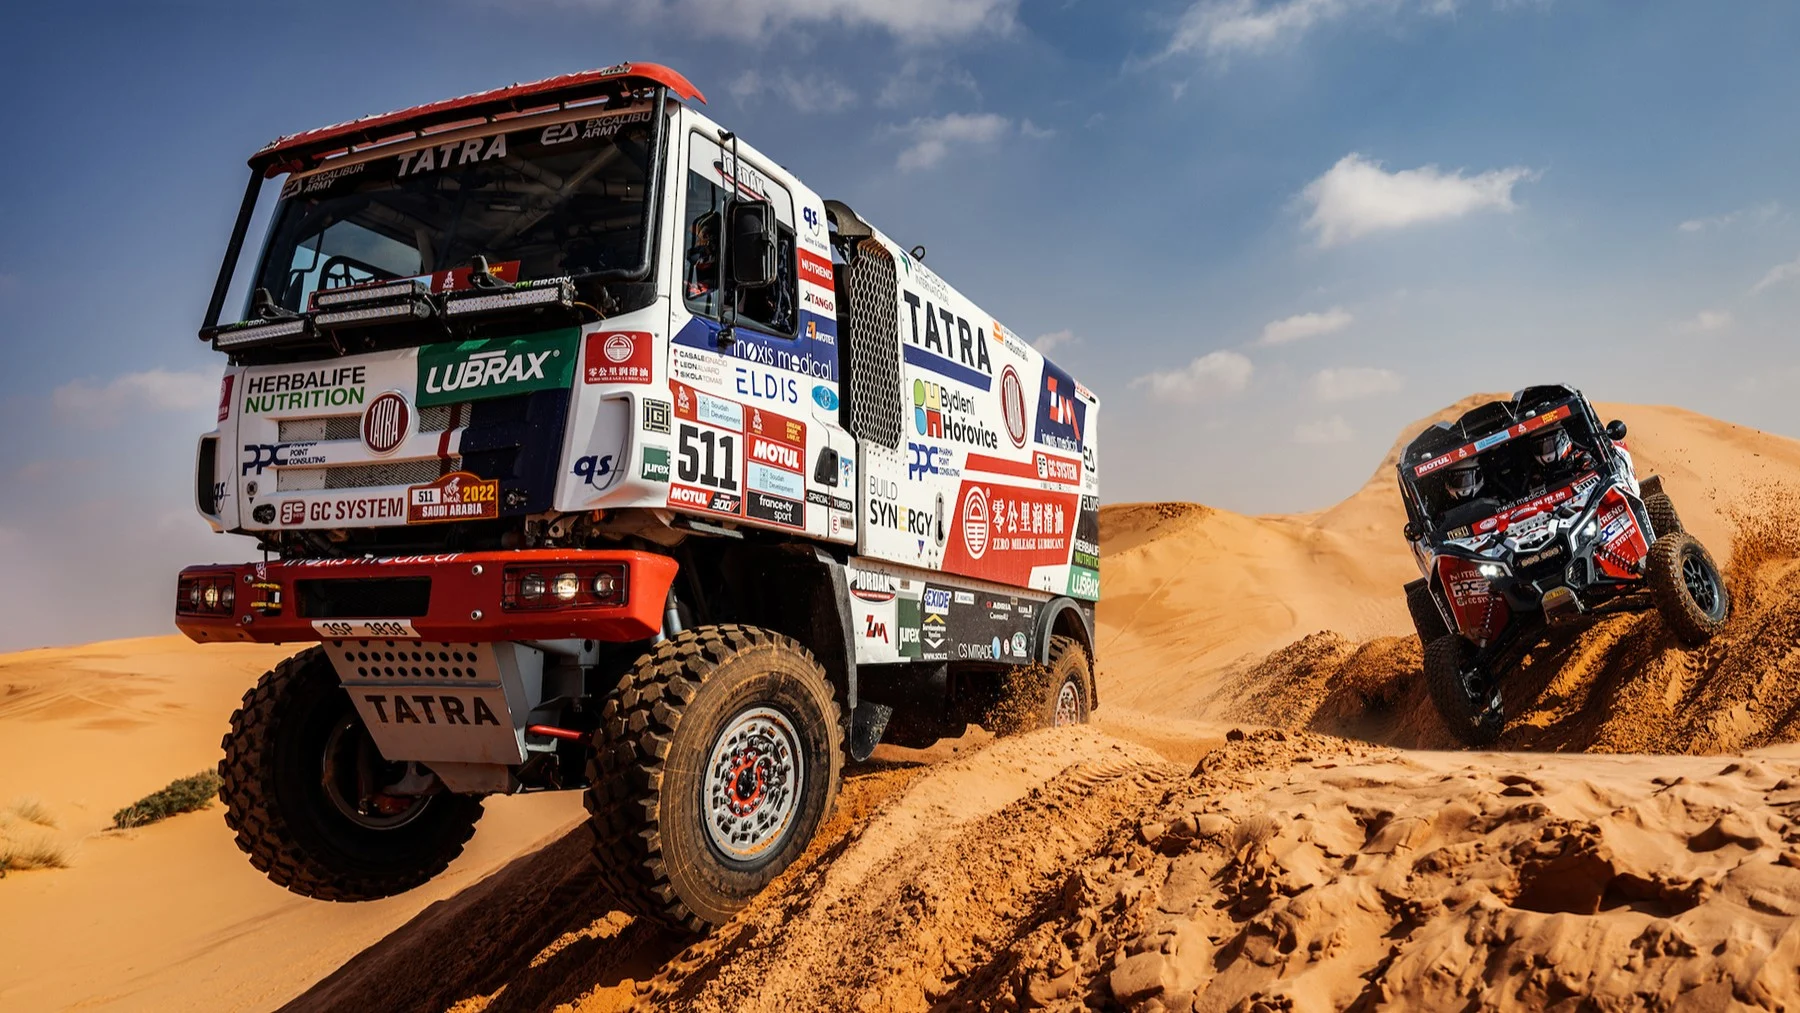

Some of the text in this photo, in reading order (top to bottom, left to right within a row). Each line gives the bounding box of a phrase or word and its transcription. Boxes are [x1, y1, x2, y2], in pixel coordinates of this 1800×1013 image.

[586, 113, 651, 131] EXCALIBU
[582, 124, 623, 140] ARMY
[397, 133, 507, 177] TATRA
[308, 163, 365, 184] EXCALIBUR
[303, 179, 336, 194] ARMY
[801, 258, 833, 280] NUTREND
[810, 294, 834, 312] TANGO
[903, 289, 993, 375] TATRA
[425, 349, 551, 394] LUBRAX
[777, 350, 833, 381] medical
[248, 366, 366, 394] HERBALIFE
[735, 367, 798, 404] ELDIS
[245, 387, 365, 414] NUTRITION
[711, 399, 730, 413] Soudah
[369, 397, 400, 448] TATRA
[710, 410, 741, 424] Development
[943, 414, 998, 449] Hořovice
[289, 456, 326, 466] CONSULTING
[290, 448, 308, 456] POINT
[678, 423, 737, 491] 511
[753, 439, 799, 469] MOTUL
[574, 455, 612, 484] qs
[644, 463, 670, 476] jurex
[1056, 461, 1078, 480] SYSTEM
[1419, 456, 1450, 474] MOTUL
[769, 473, 784, 482] Soudah
[418, 490, 433, 503] 511
[463, 484, 495, 502] 2022
[670, 487, 707, 505] MOTUL
[769, 482, 794, 494] Development
[870, 475, 898, 500] BUILD
[1516, 487, 1548, 505] medical
[310, 497, 404, 521] GC SYSTEM
[422, 503, 483, 518] SAUDI ARABIA
[774, 510, 792, 523] sport
[870, 498, 933, 537] SYNERGY
[991, 498, 1064, 535] 零公里润滑油
[993, 537, 1064, 550] ZERO MILEAGE LUBRICANT
[926, 590, 949, 609] EXIDE
[992, 602, 1012, 611] ADRIA
[365, 621, 408, 636] 3838
[900, 627, 920, 650] jurex
[364, 695, 501, 726] TATRA
